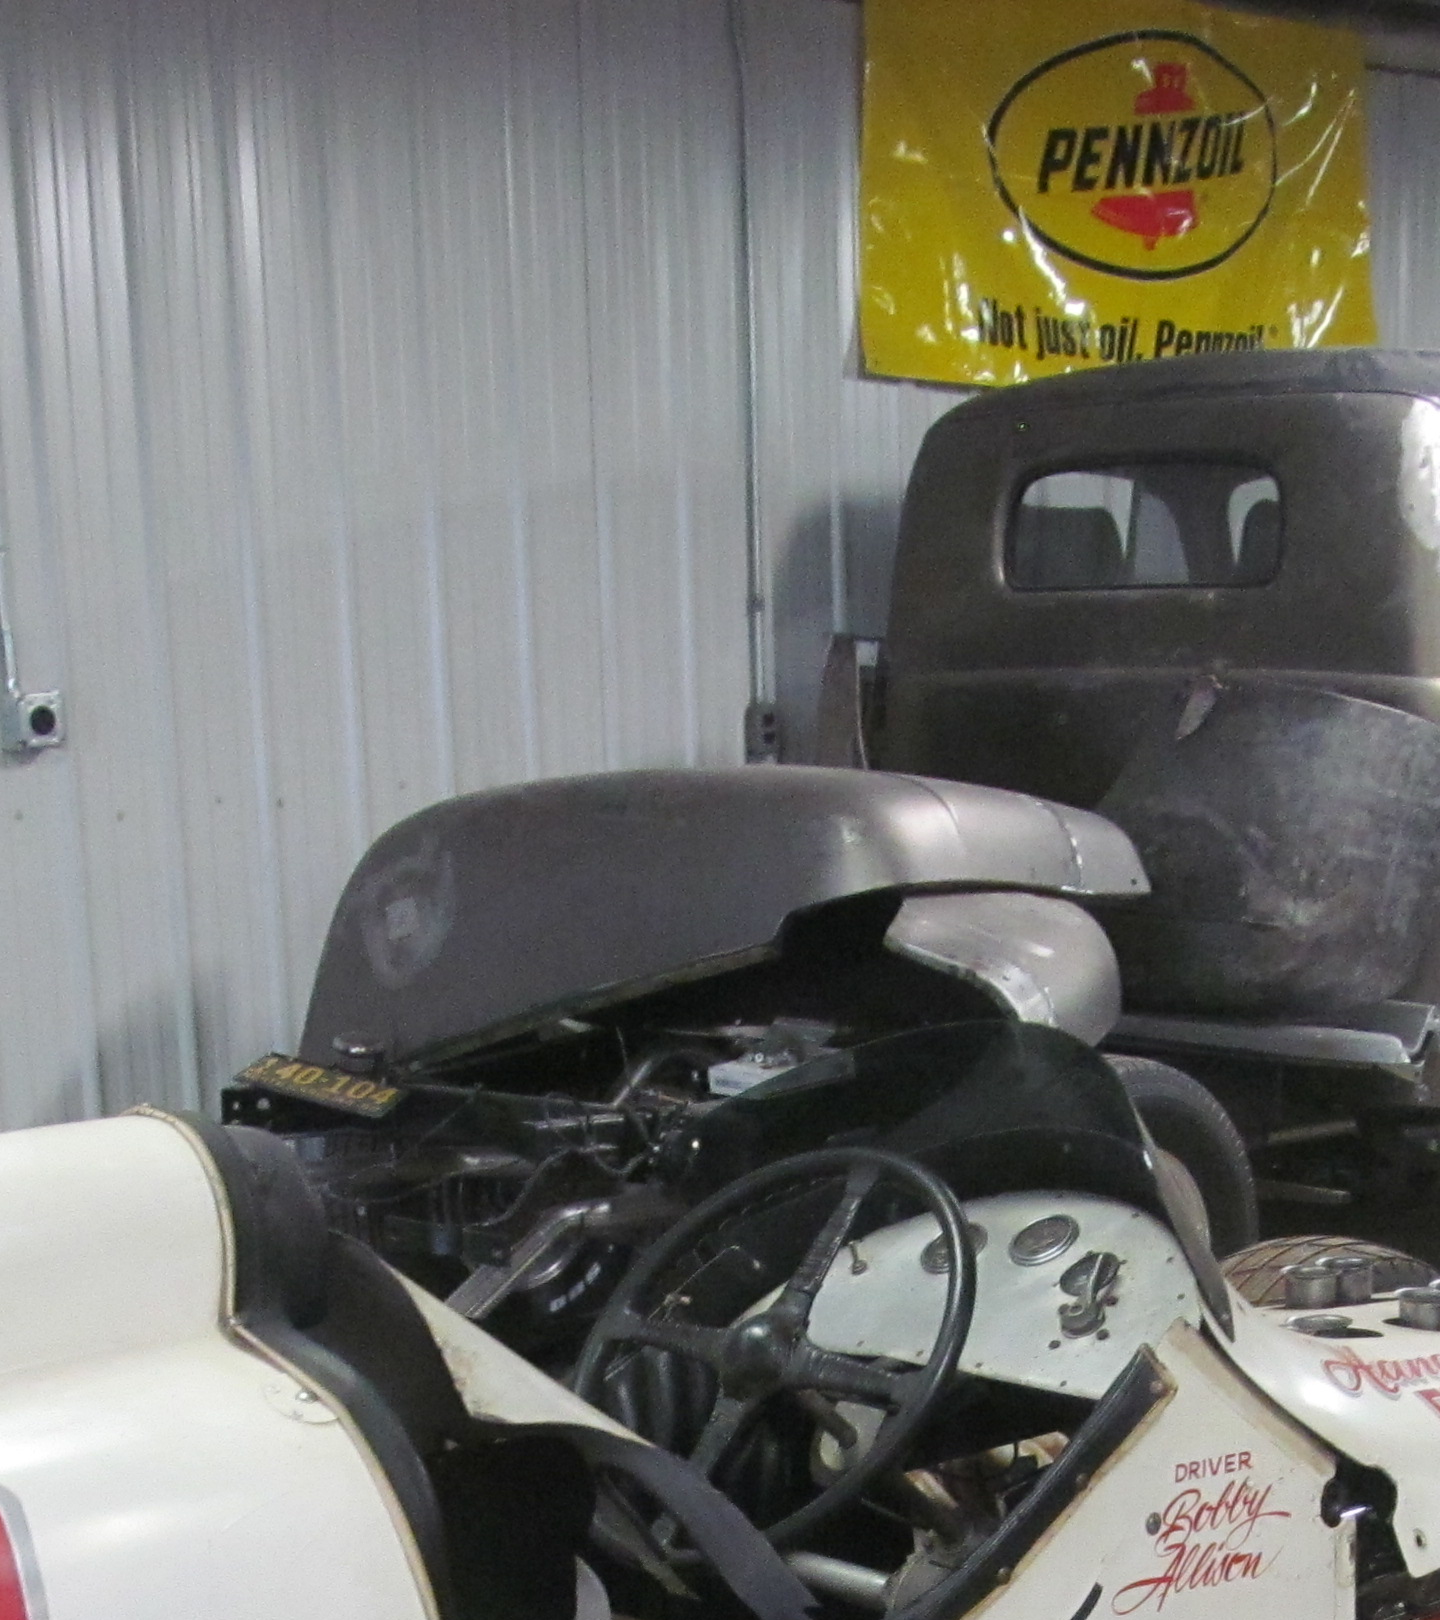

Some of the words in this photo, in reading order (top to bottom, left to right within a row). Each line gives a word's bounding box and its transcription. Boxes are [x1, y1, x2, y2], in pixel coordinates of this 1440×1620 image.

[1037, 113, 1245, 193] PENNZOIL
[979, 298, 1026, 350] Not
[1034, 306, 1090, 361] just
[1097, 317, 1143, 363] oil.
[1175, 1451, 1253, 1483] DRIVER
[1155, 1477, 1292, 1557] Bobby
[1112, 1543, 1281, 1616] Allison
